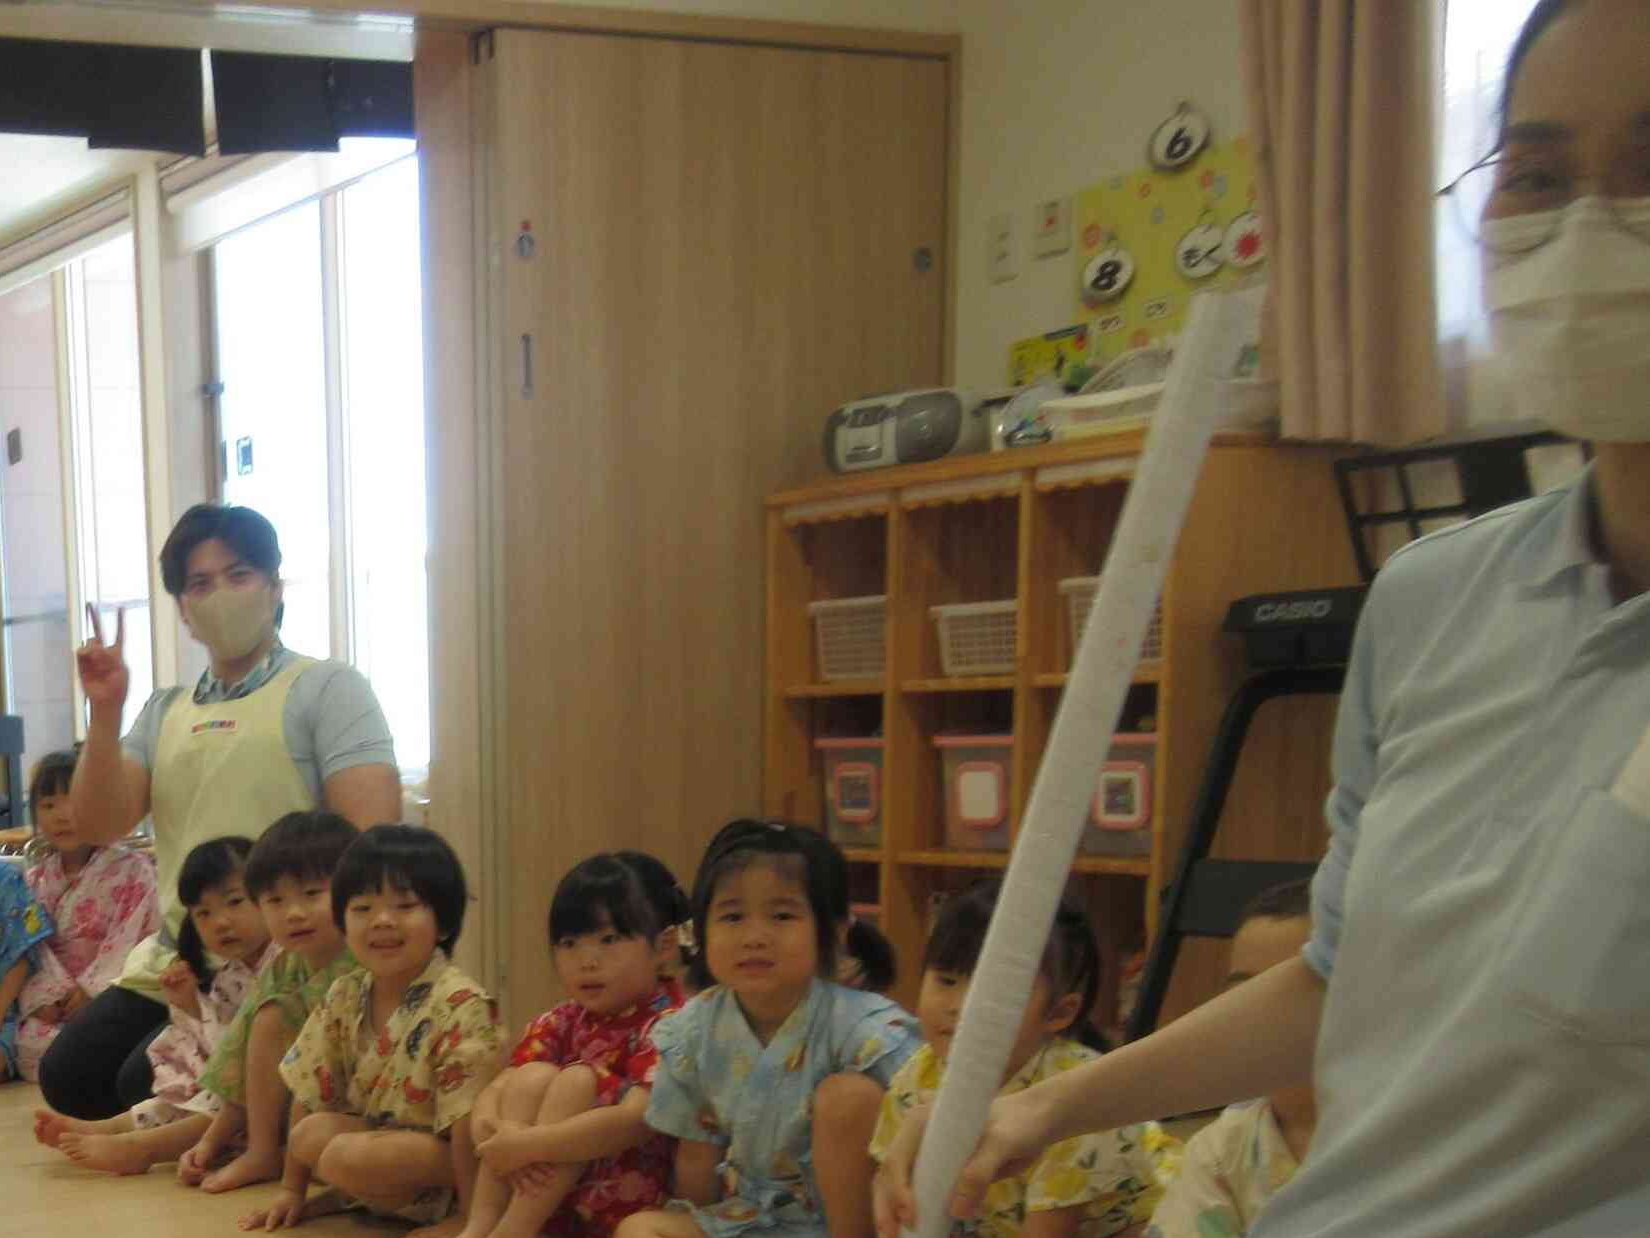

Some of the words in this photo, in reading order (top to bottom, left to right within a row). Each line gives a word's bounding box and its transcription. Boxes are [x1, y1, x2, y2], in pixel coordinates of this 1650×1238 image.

[1165, 127, 1193, 161] 6
[1091, 260, 1123, 291] 8
[1255, 600, 1332, 622] CASIO
